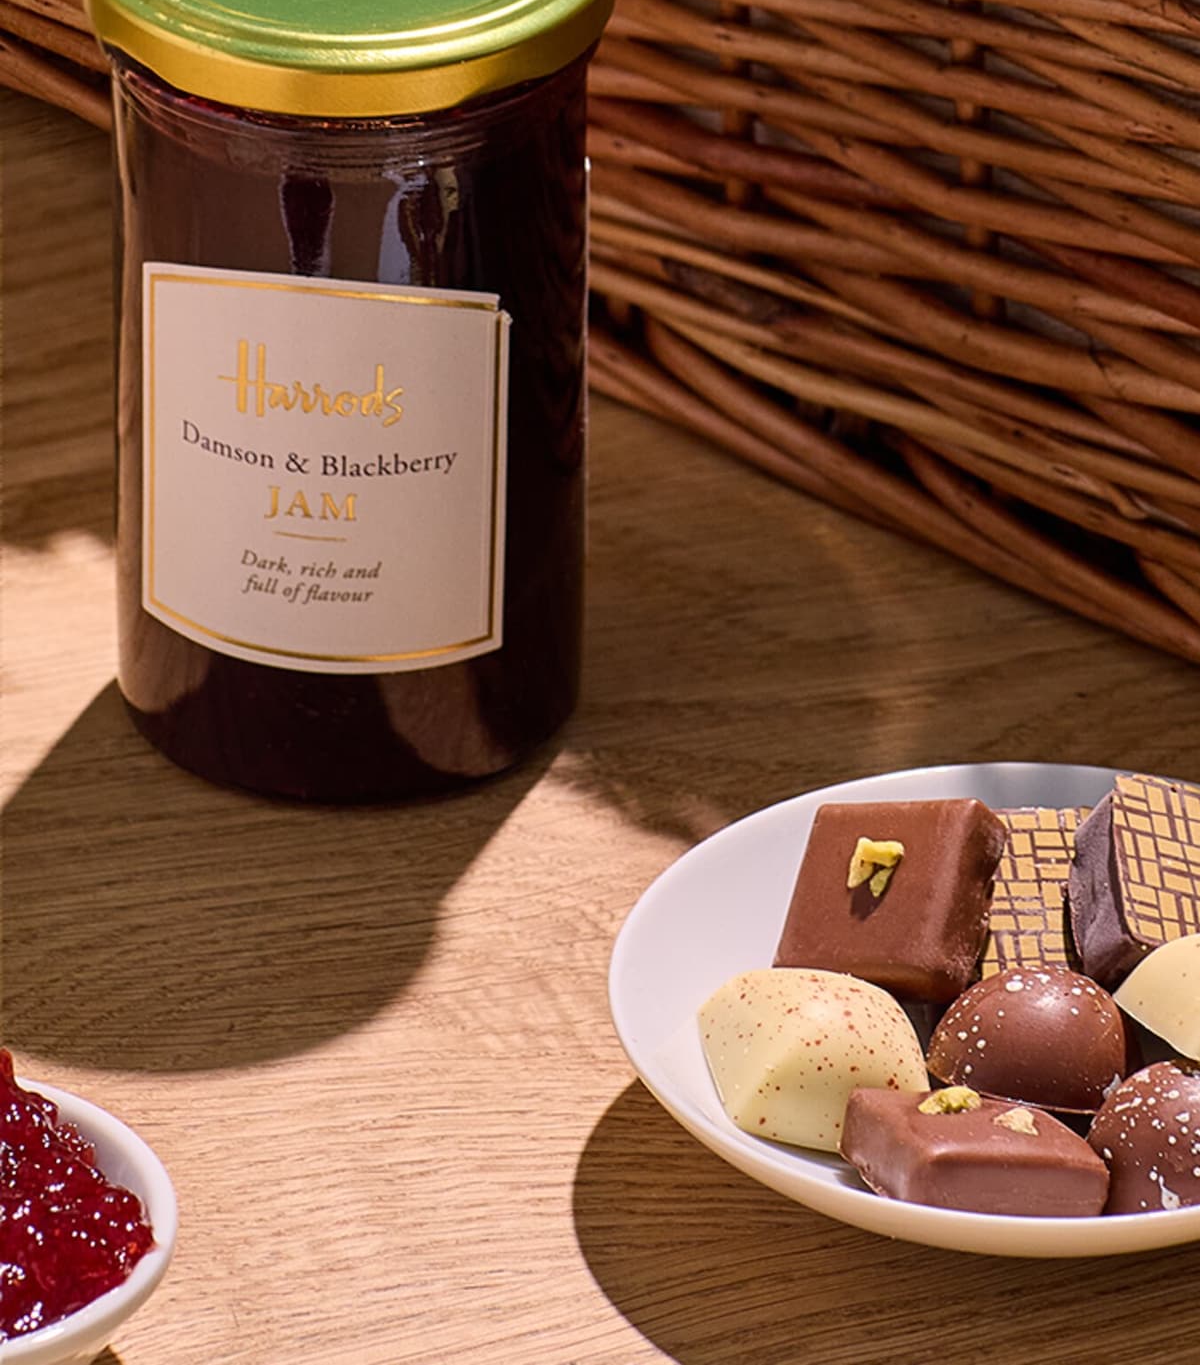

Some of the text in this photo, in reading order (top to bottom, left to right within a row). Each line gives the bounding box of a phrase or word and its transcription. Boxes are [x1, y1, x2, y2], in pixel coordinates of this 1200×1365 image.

[216, 339, 403, 427] Harrods
[182, 420, 458, 478] Damson & Blackberry
[264, 485, 358, 522] JAM
[240, 549, 382, 580] Dark, rich and
[243, 574, 373, 604] full of flavour
